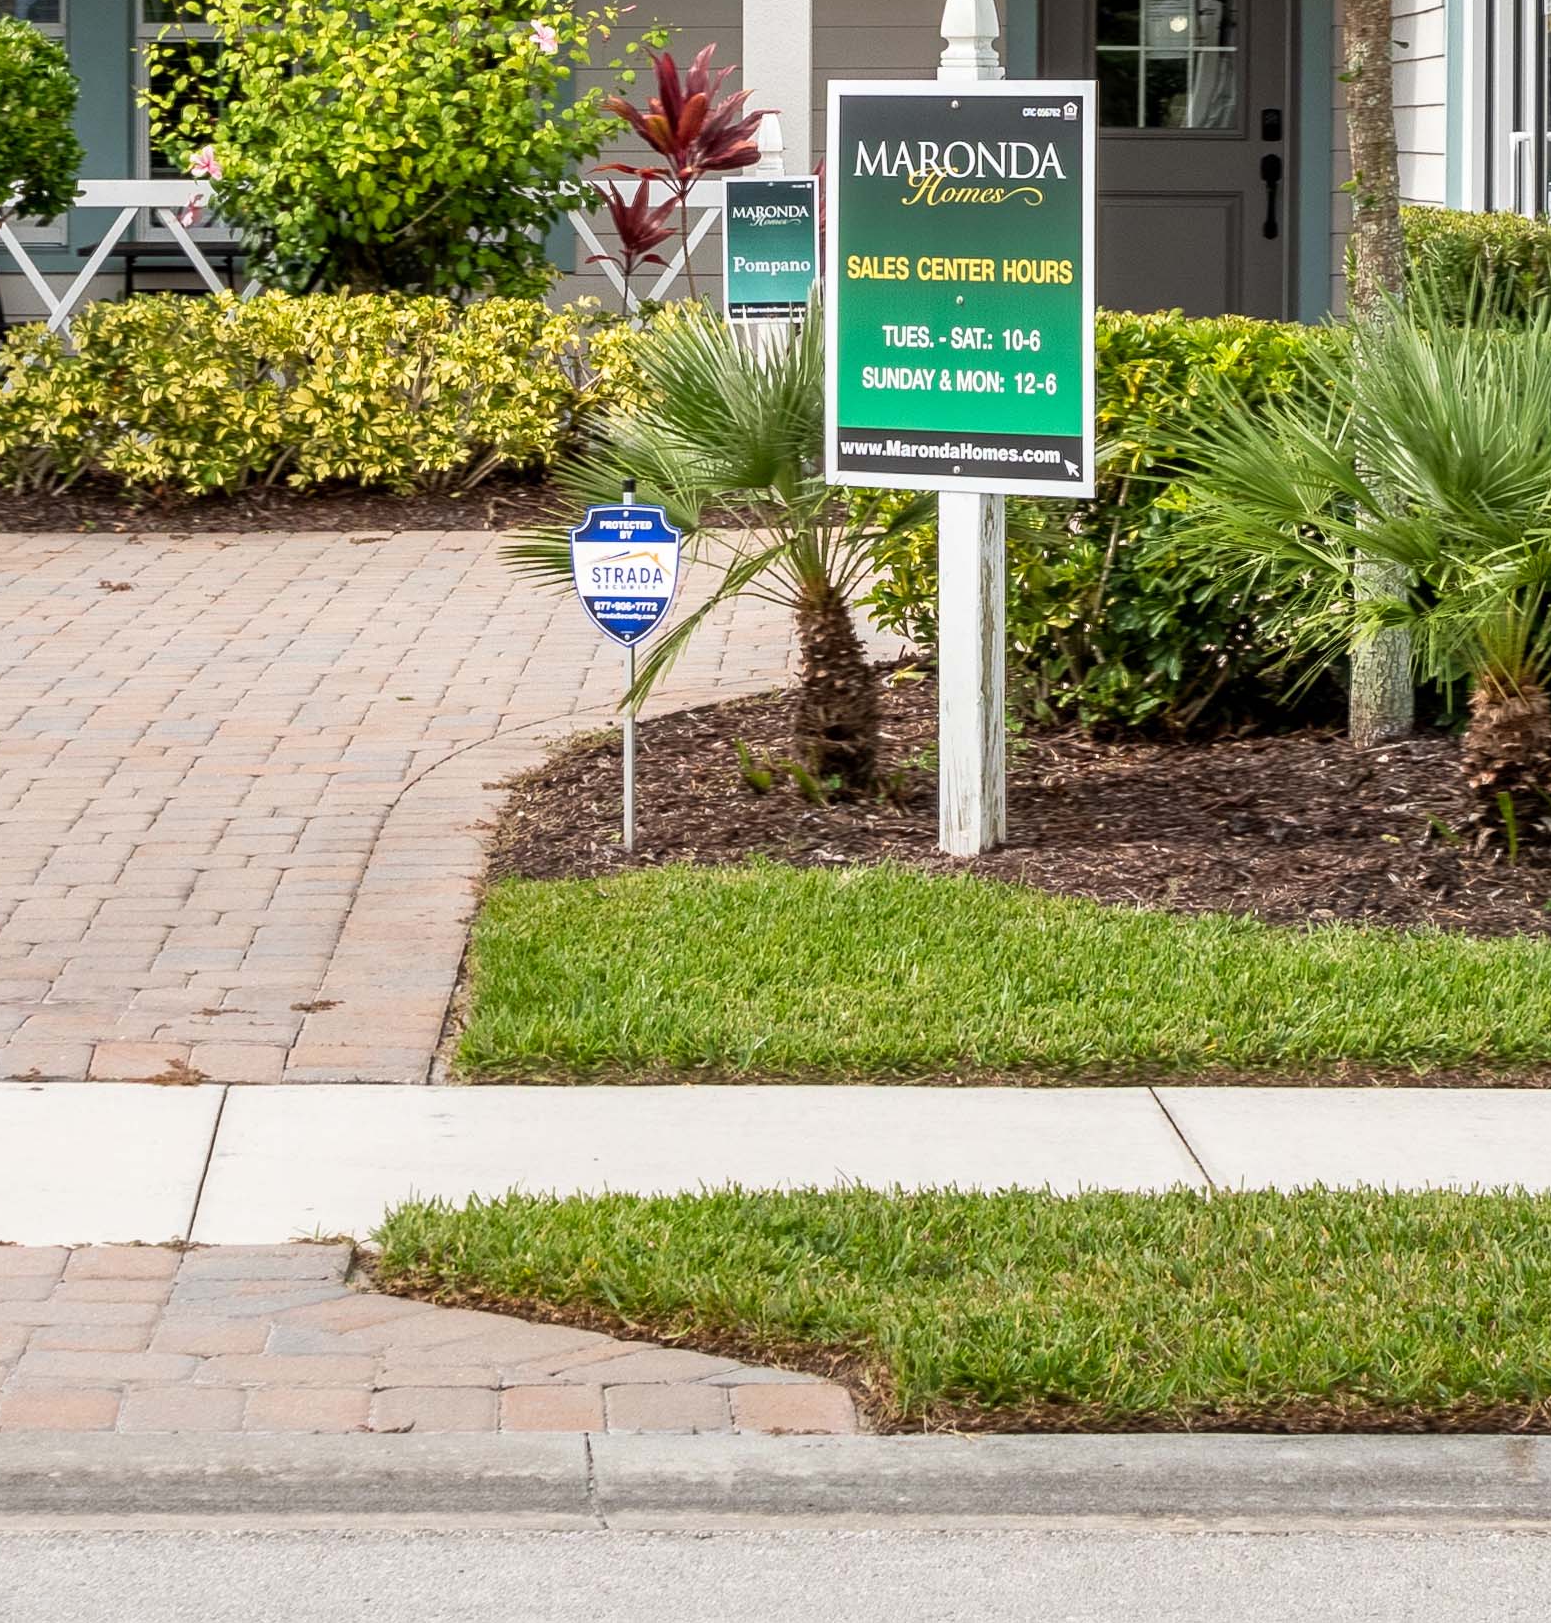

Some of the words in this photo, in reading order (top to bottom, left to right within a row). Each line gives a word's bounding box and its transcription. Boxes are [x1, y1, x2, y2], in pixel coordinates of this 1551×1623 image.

[853, 140, 1066, 180] MARONDA
[901, 165, 1043, 207] Homes
[732, 205, 809, 218] MARONDA
[750, 216, 802, 226] Homes
[732, 257, 811, 275] Pompano
[847, 255, 909, 281] SALES
[916, 257, 995, 282] CENTER
[1002, 259, 1073, 284] HOURS
[882, 325, 935, 348] TUES.
[1002, 328, 1041, 353] 10-6
[862, 366, 936, 392] SUNDAY
[940, 369, 952, 392] &
[956, 370, 1005, 394] MON:
[1013, 372, 1057, 396] 12-6
[840, 439, 1061, 465] www.MarondaHomes.com
[600, 520, 653, 530] PROTECTED
[619, 530, 633, 539] BY
[592, 567, 663, 584] STRADA
